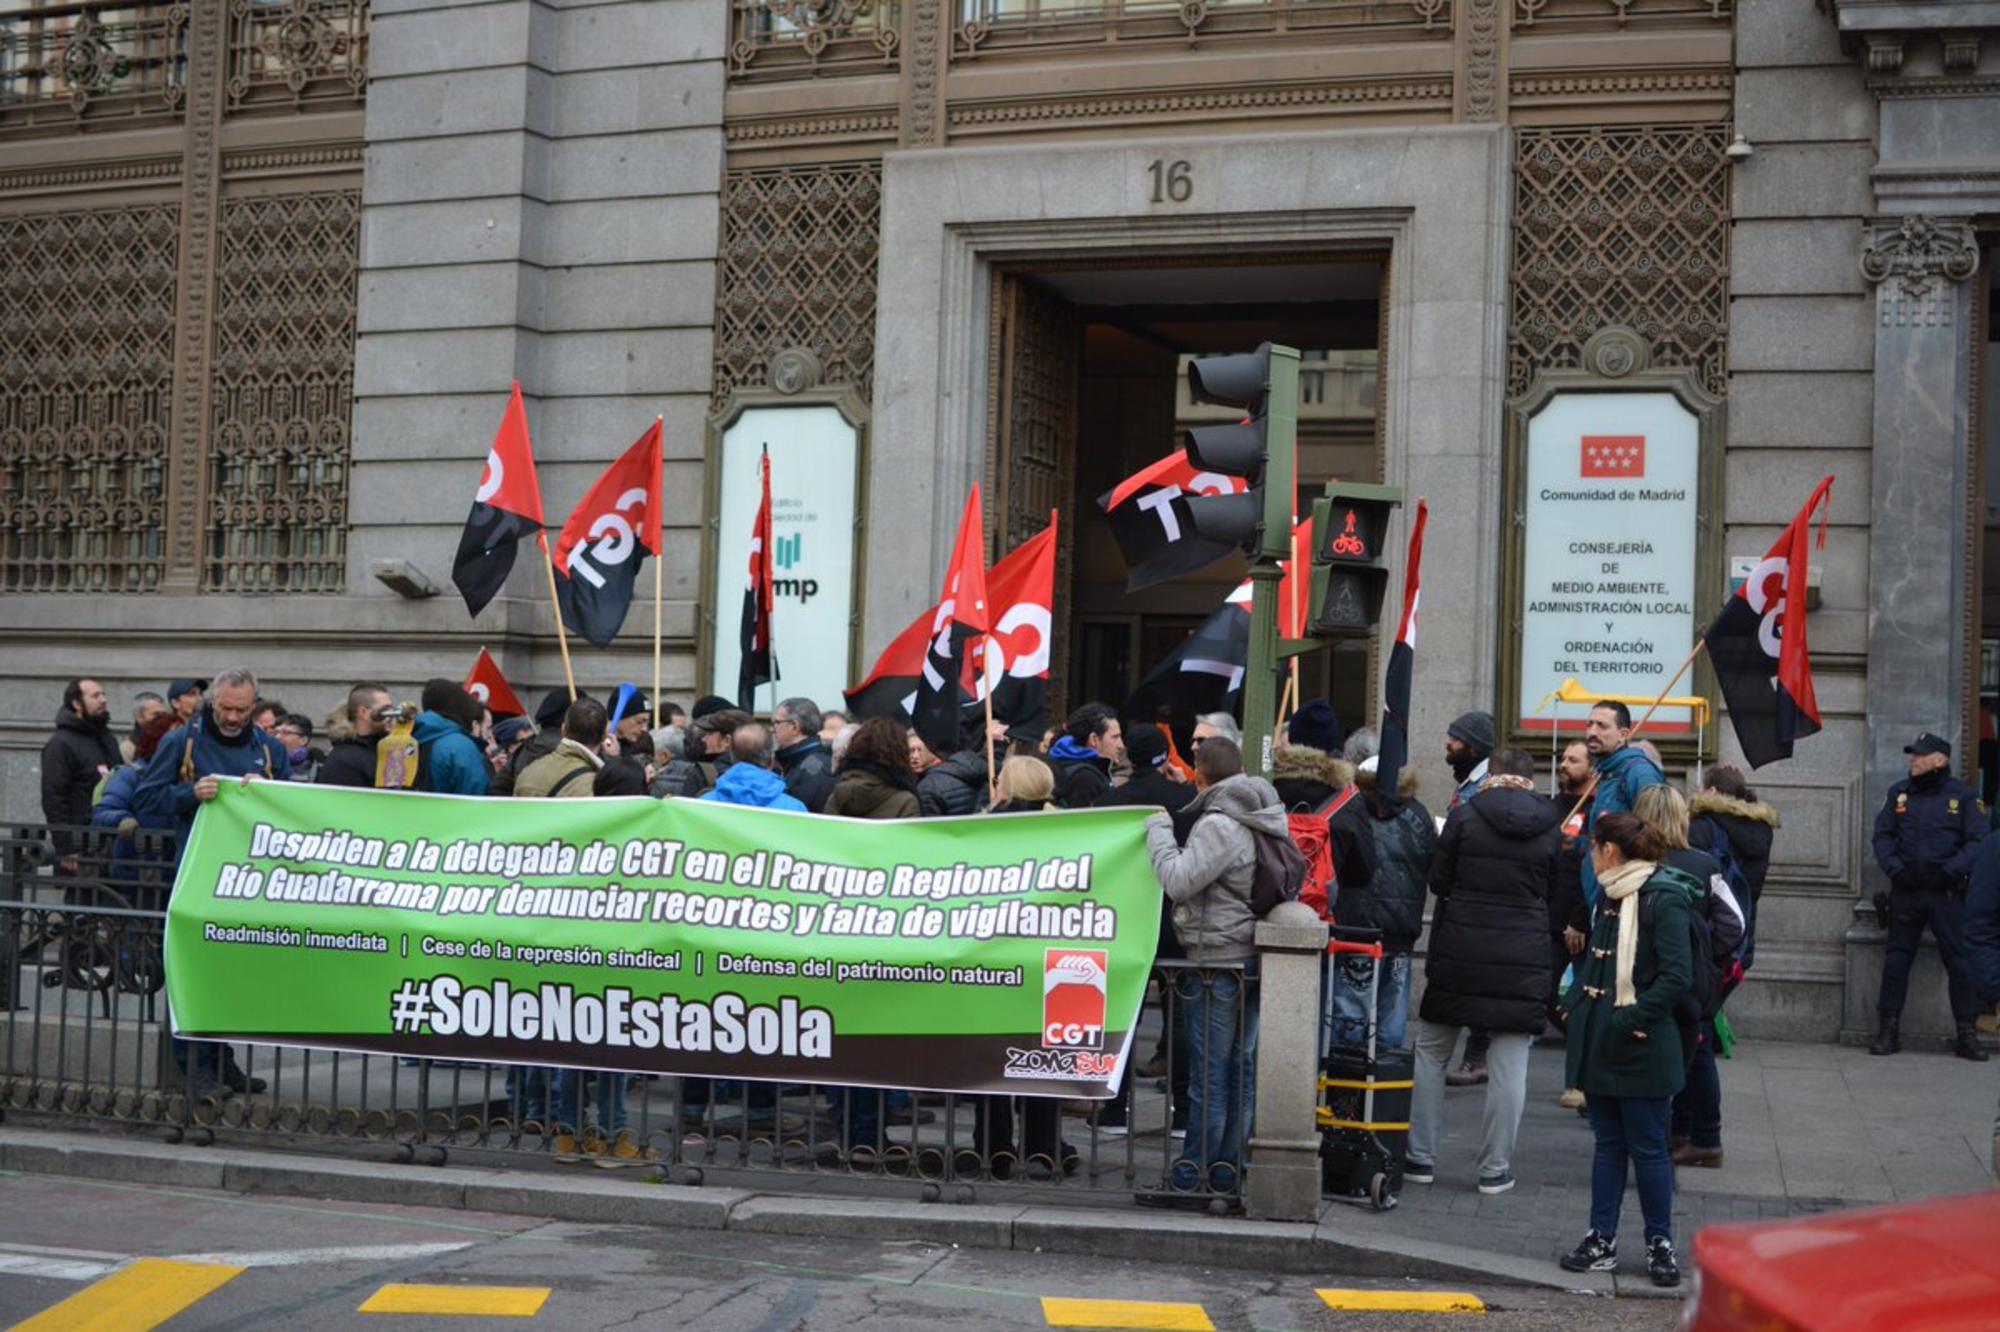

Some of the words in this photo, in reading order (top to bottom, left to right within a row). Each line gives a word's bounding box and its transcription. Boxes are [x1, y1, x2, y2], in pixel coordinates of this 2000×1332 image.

[1147, 159, 1194, 203] 16
[1540, 489, 1615, 501] Comunidad
[1619, 489, 1635, 501] de
[1639, 490, 1685, 501] Madrid
[1568, 541, 1654, 554] CONSEJERÍA
[1601, 563, 1619, 574] DE
[1551, 582, 1593, 594] MEDIO
[1597, 583, 1669, 595] AMBIENTE,
[1529, 599, 1643, 614] ADMINISTRACIÓN
[1646, 603, 1691, 614] LOCAL
[1605, 623, 1613, 633] Y
[1564, 638, 1653, 653] ORDENACIÓN
[1554, 662, 1579, 673] DEL
[1584, 662, 1664, 674] TERRITORIO
[251, 823, 384, 867] Despiden
[386, 839, 409, 869] a
[409, 837, 440, 873] la
[443, 838, 576, 878] delegada
[579, 840, 616, 876] de
[621, 840, 683, 878] CGT
[684, 848, 727, 882] en
[731, 848, 767, 887] el
[769, 851, 889, 897] Parque
[890, 859, 1035, 898] Regional
[1036, 853, 1092, 894] del
[213, 863, 263, 900] Río
[265, 866, 436, 909] Guadarrama
[437, 884, 495, 915] por
[496, 882, 649, 921] denunciar
[652, 891, 794, 932] recortes
[795, 904, 821, 937] y
[820, 902, 898, 937] falta
[900, 904, 945, 939] de
[947, 901, 1117, 941] vigilancia
[204, 922, 301, 946] Readmisión
[304, 929, 388, 952] inmediata
[422, 936, 467, 957] Cese
[471, 940, 492, 958] de
[497, 942, 514, 960] la
[516, 943, 602, 967] represión
[607, 950, 681, 970] sindical
[718, 953, 797, 976] Defensa
[802, 957, 832, 979] del
[837, 960, 946, 986] patrimonio
[951, 965, 1024, 987] natural
[392, 976, 834, 1058] #SoleNoEstaSola
[1046, 1022, 1101, 1045] CGT
